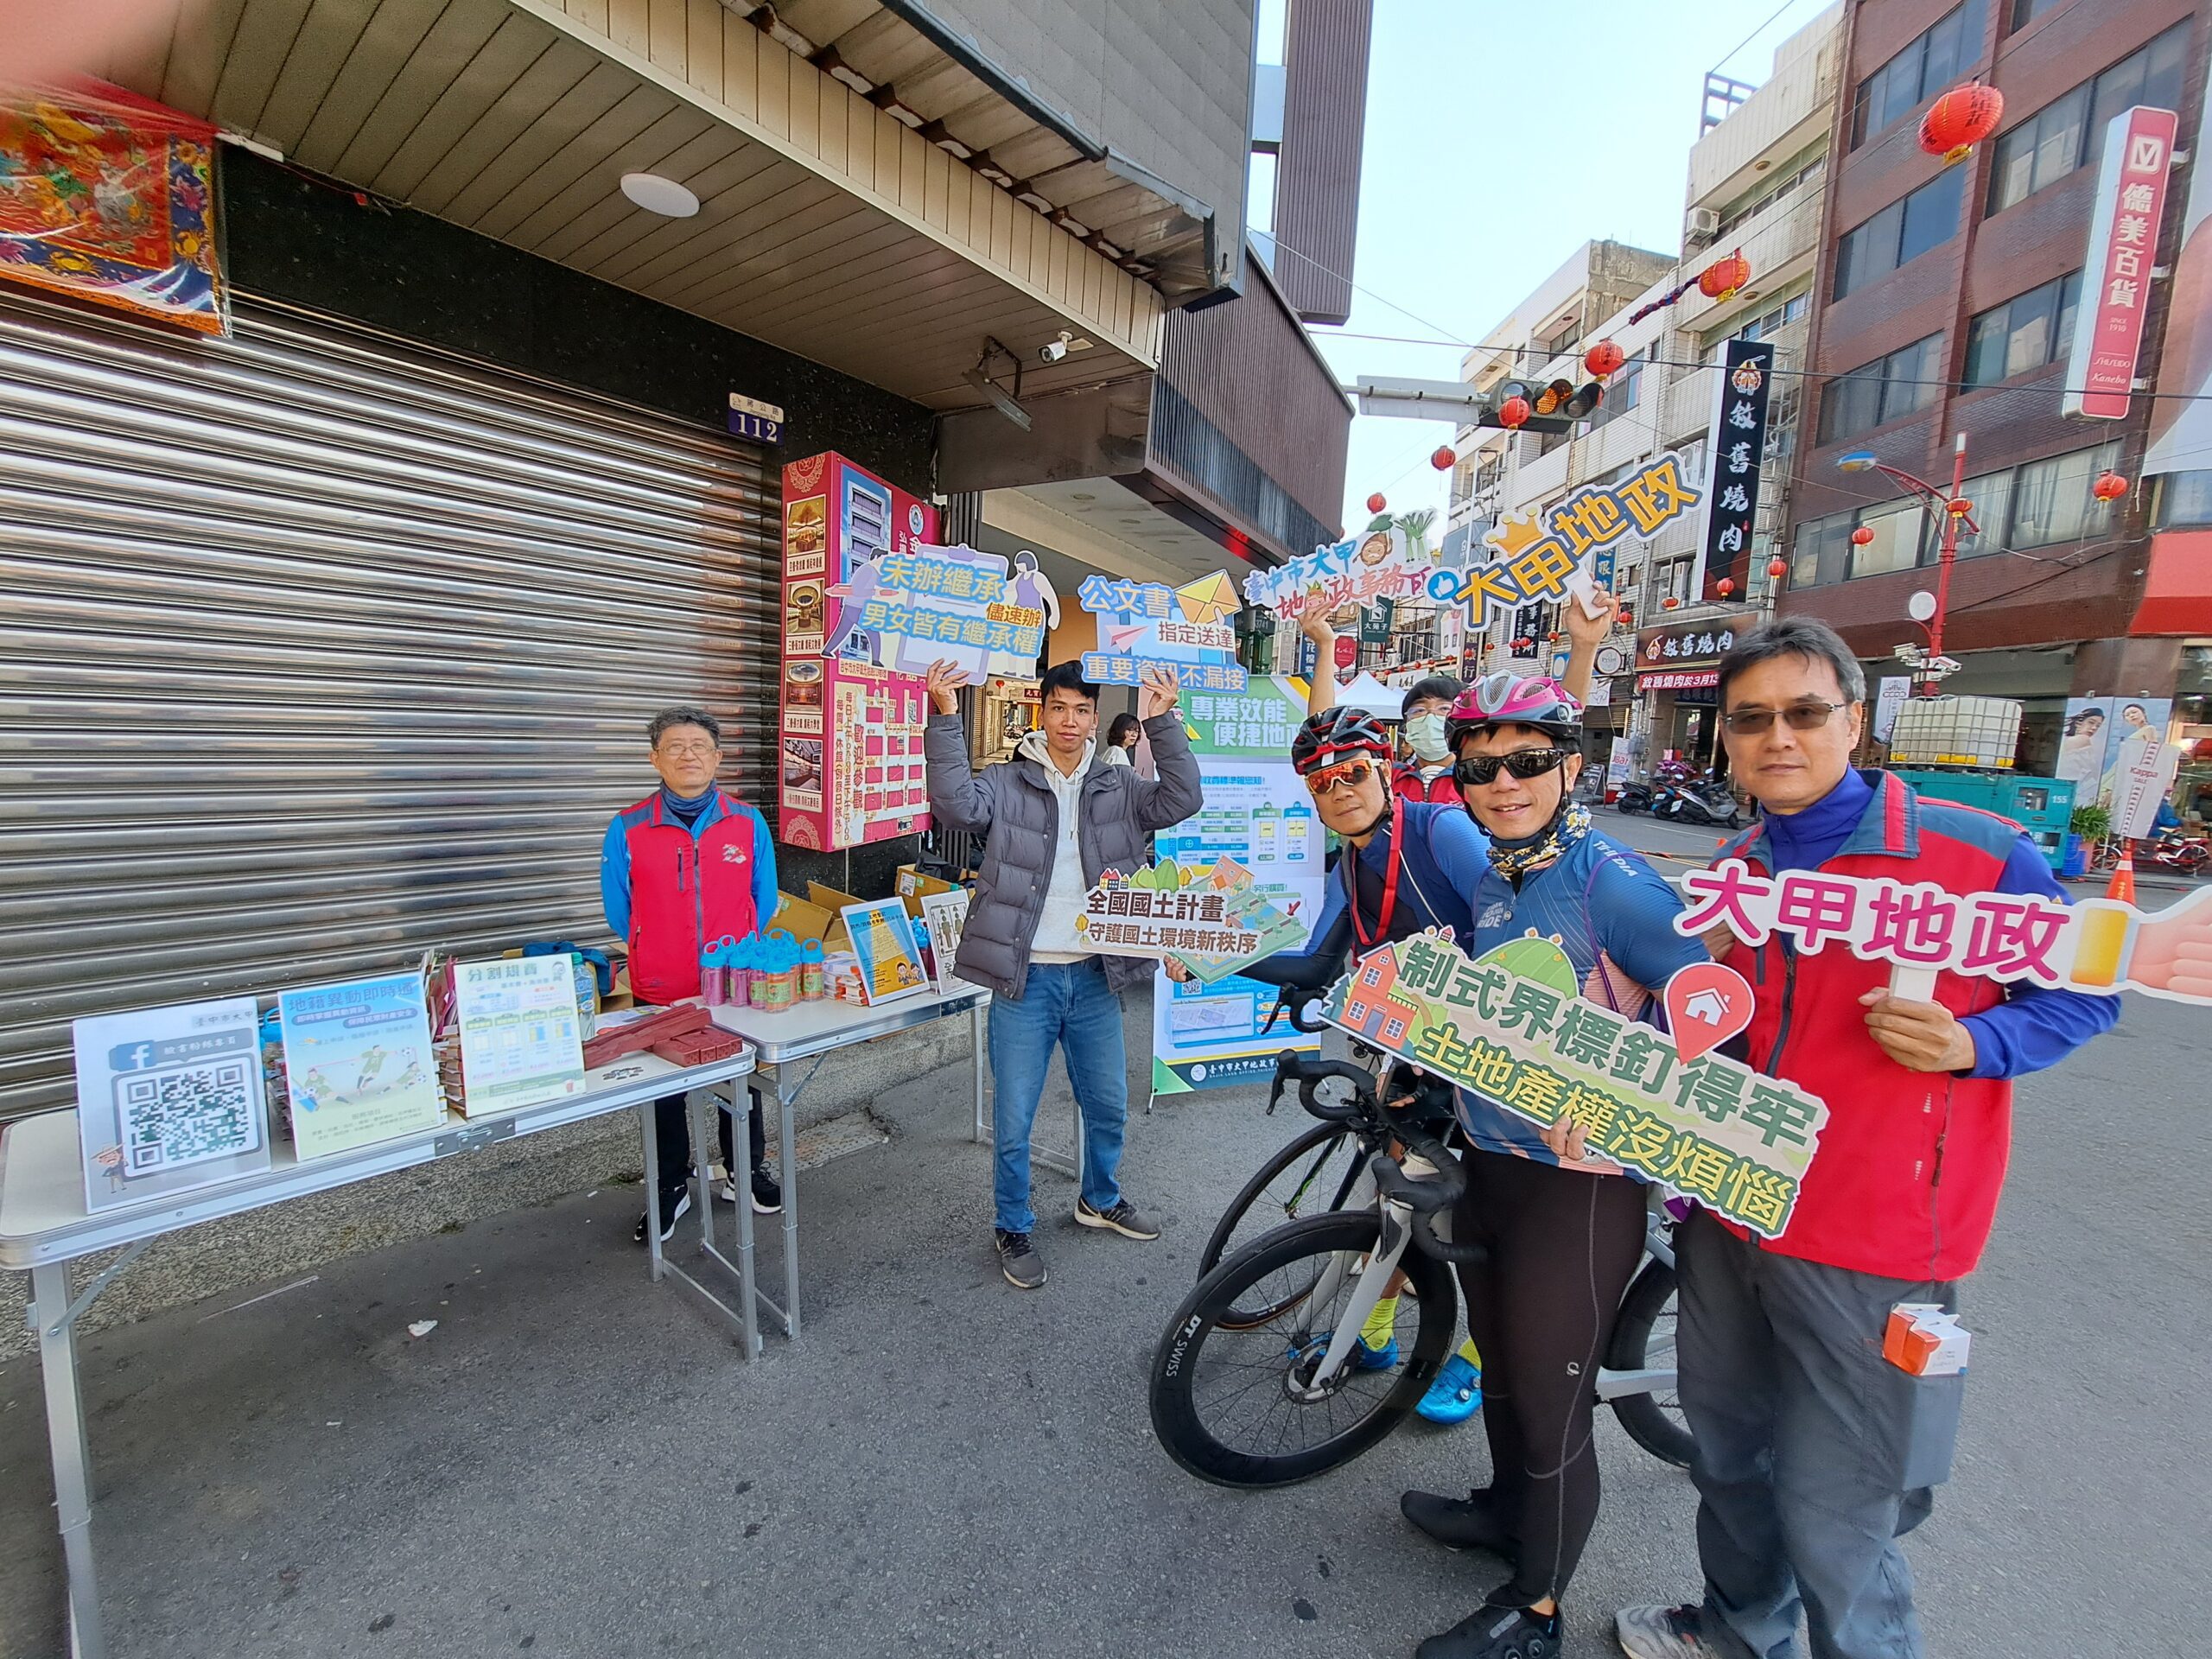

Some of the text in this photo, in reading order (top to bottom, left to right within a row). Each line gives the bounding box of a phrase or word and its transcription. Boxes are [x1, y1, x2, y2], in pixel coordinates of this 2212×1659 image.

[2092, 372, 2126, 385] Kanebo
[2094, 357, 2131, 368] SHISEIDO
[738, 414, 778, 442] 112
[1455, 461, 1697, 625] 大甲地政
[883, 556, 1004, 601] 未辦繼承
[1245, 539, 1357, 602] 臺中市大甲
[986, 602, 1043, 627] 儘速辦
[1084, 579, 1172, 620] 公文書
[861, 603, 1040, 654] 男女皆有繼承權
[1158, 620, 1234, 649] 指定送達
[1191, 696, 1287, 723] 專業效能
[2129, 766, 2158, 779] Kappa
[2051, 794, 2069, 804] 155
[1086, 889, 1225, 924] 全國國土計畫
[1476, 914, 1503, 929] RIDE
[1088, 921, 1259, 955] 守護國土環境新秩序
[1681, 866, 2070, 982] 大甲地政
[288, 981, 415, 1014] 地籍異動即時通
[1399, 938, 1819, 1148] 制式界標釘得牢
[1208, 1058, 1279, 1075] 臺中市大甲地政事
[1415, 1025, 1795, 1232] 土地產權沒煩惱
[1185, 1314, 1203, 1338] DT
[1166, 1339, 1188, 1377] SWISS
